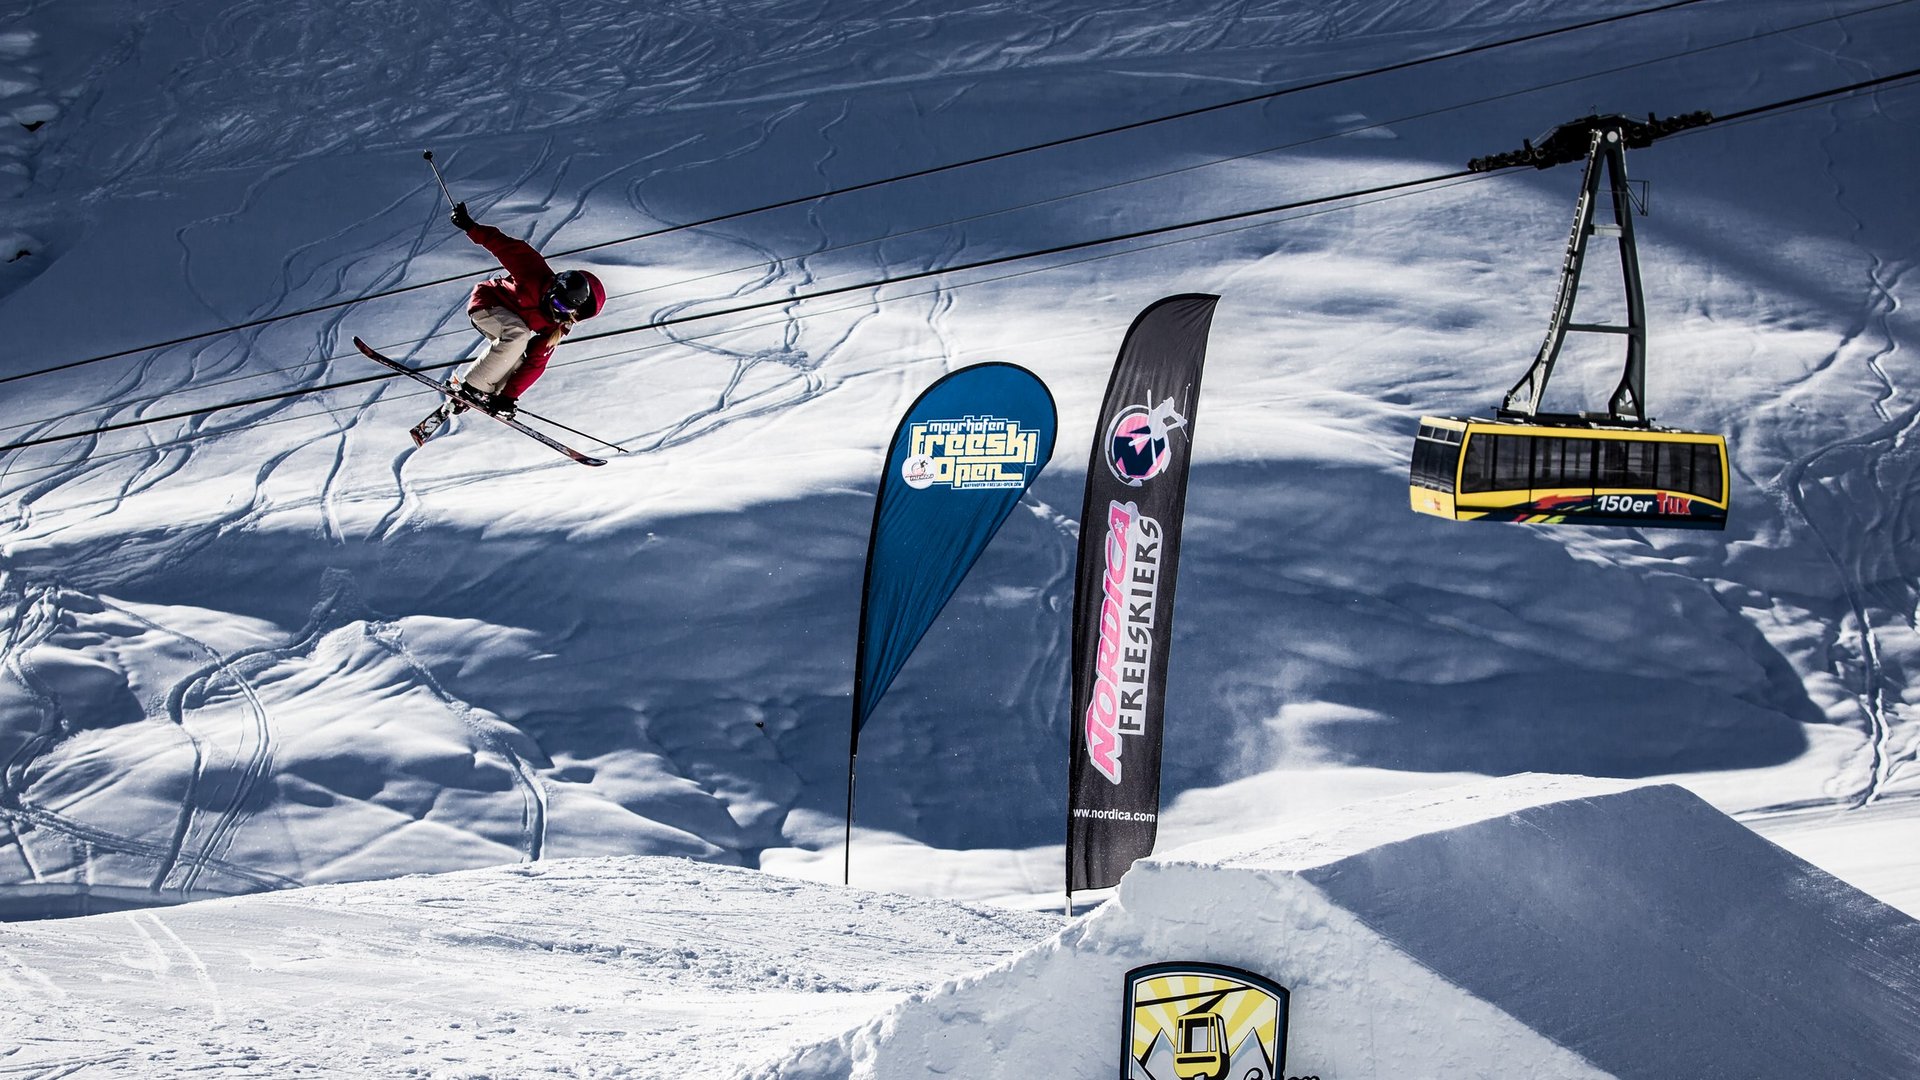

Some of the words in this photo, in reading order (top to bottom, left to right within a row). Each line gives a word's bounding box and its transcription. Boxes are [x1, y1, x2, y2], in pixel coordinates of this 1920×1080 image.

[929, 418, 1005, 434] mayrhofen
[934, 456, 1024, 487] Open
[1597, 495, 1653, 512] 150er
[1120, 517, 1159, 732] FREESKIERS
[1087, 503, 1132, 779] NORDICA
[1072, 808, 1156, 823] ww.nordica.com
